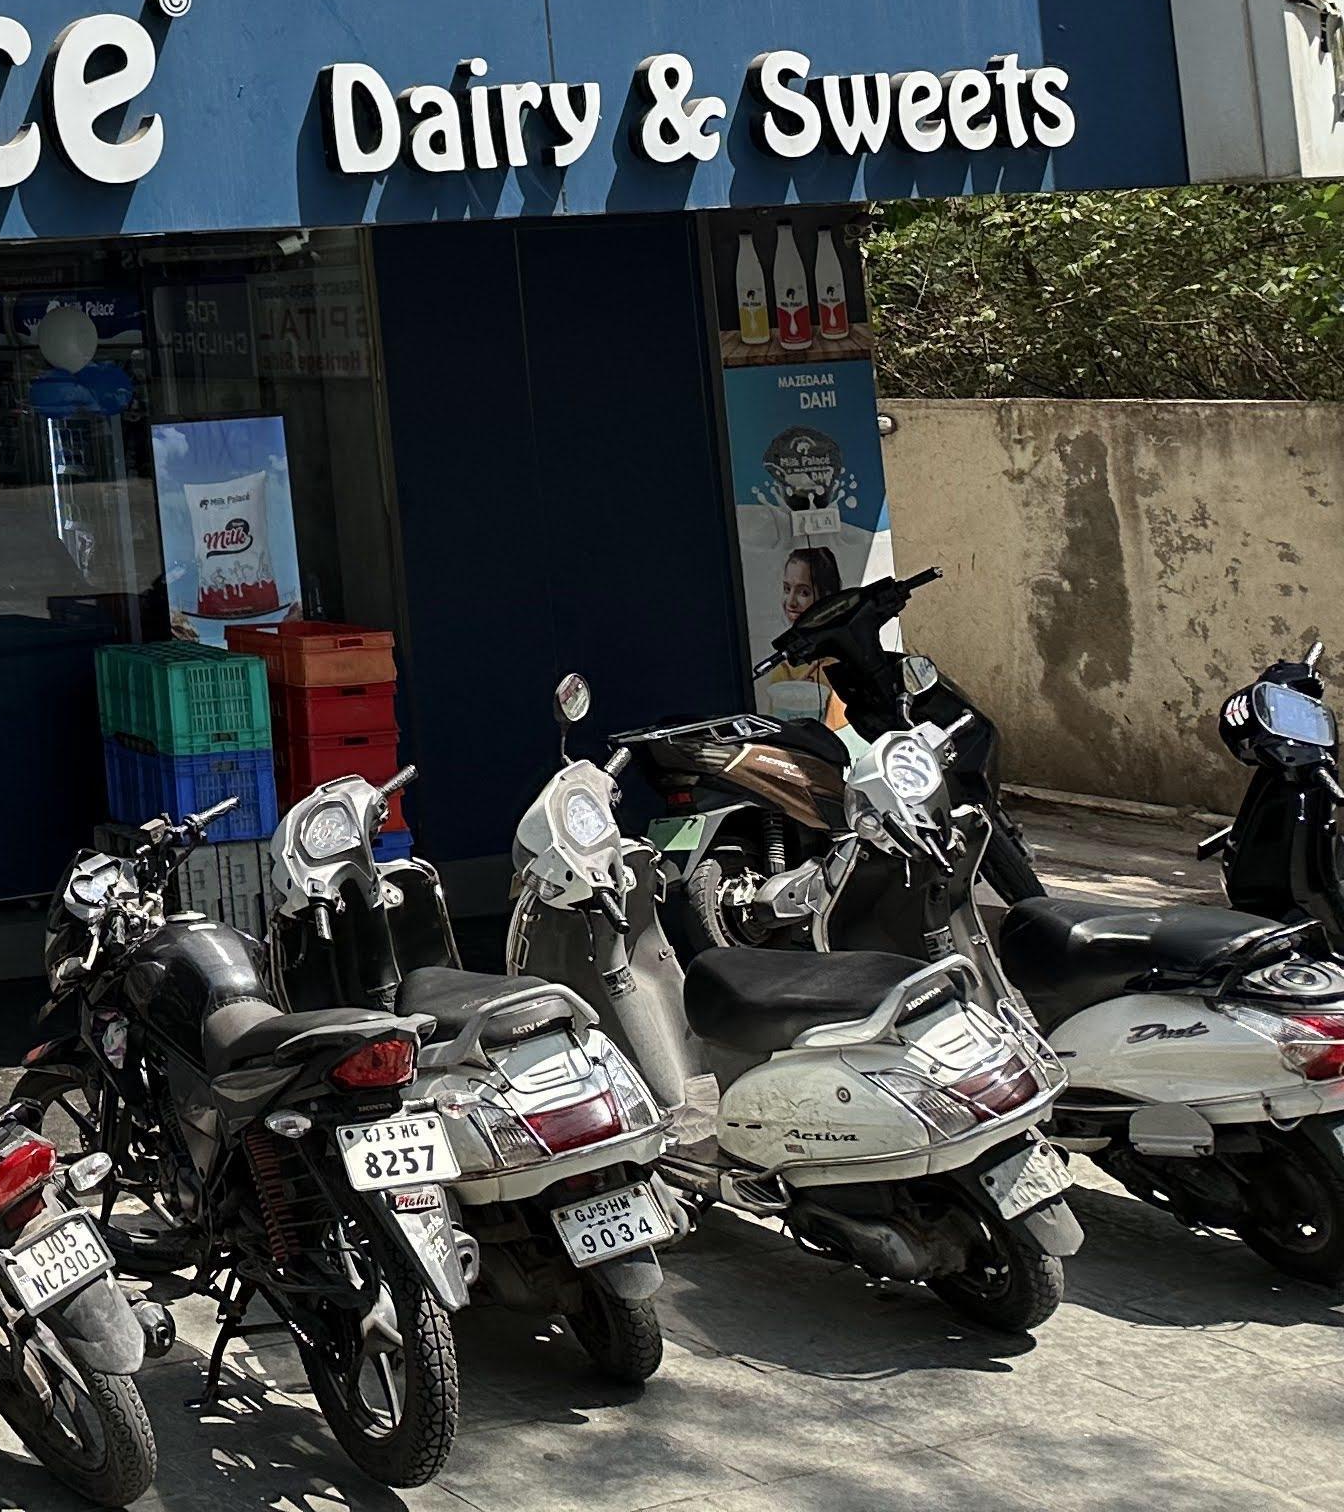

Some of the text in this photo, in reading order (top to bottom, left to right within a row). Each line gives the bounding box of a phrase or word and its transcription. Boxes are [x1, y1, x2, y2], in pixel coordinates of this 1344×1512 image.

[328, 49, 1076, 174] Dairy & Sweets
[777, 373, 835, 389] MAZEDAAR
[799, 390, 837, 409] DAHI
[203, 526, 247, 550] Milk
[783, 1128, 860, 1143] Activa
[364, 1144, 435, 1179] 8257
[30, 1226, 78, 1268] GJ05
[580, 1216, 654, 1255] 9034
[31, 1242, 102, 1298] NC2903
